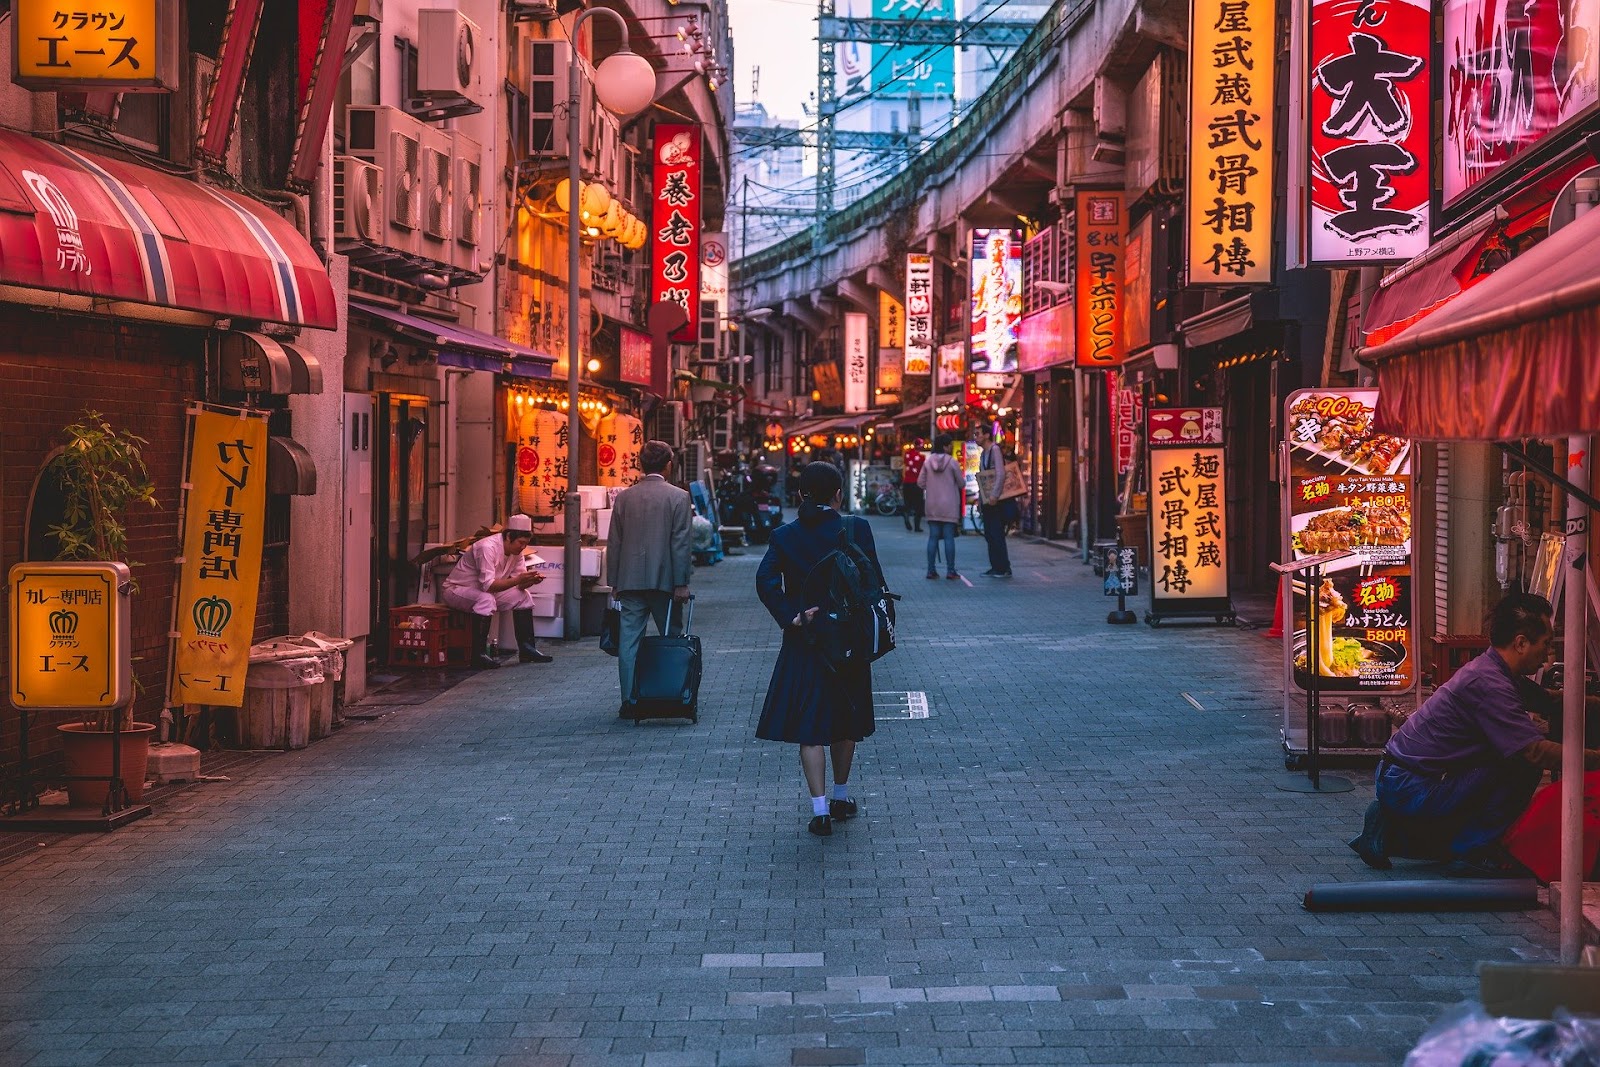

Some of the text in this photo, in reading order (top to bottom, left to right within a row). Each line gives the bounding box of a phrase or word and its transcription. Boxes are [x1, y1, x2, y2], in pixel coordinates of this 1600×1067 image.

[52, 11, 125, 31] クラウン
[36, 36, 140, 70] エース
[1346, 247, 1396, 256] 上野アメ横店
[56, 247, 92, 276] クラウン
[1295, 418, 1321, 443] 串
[1301, 476, 1327, 486] Specialty
[1337, 483, 1406, 493] 牛タン野菜巻き
[1302, 482, 1330, 501] 名物
[1192, 452, 1221, 568] 麺屋武蔵
[1120, 549, 1135, 594] 営業中
[1361, 577, 1386, 587] Specialty
[25, 588, 102, 605] カレー専門店
[1360, 583, 1395, 606] 名物
[1346, 613, 1408, 627] かすうどん
[1367, 630, 1406, 642] 580円
[39, 655, 89, 672] エース
